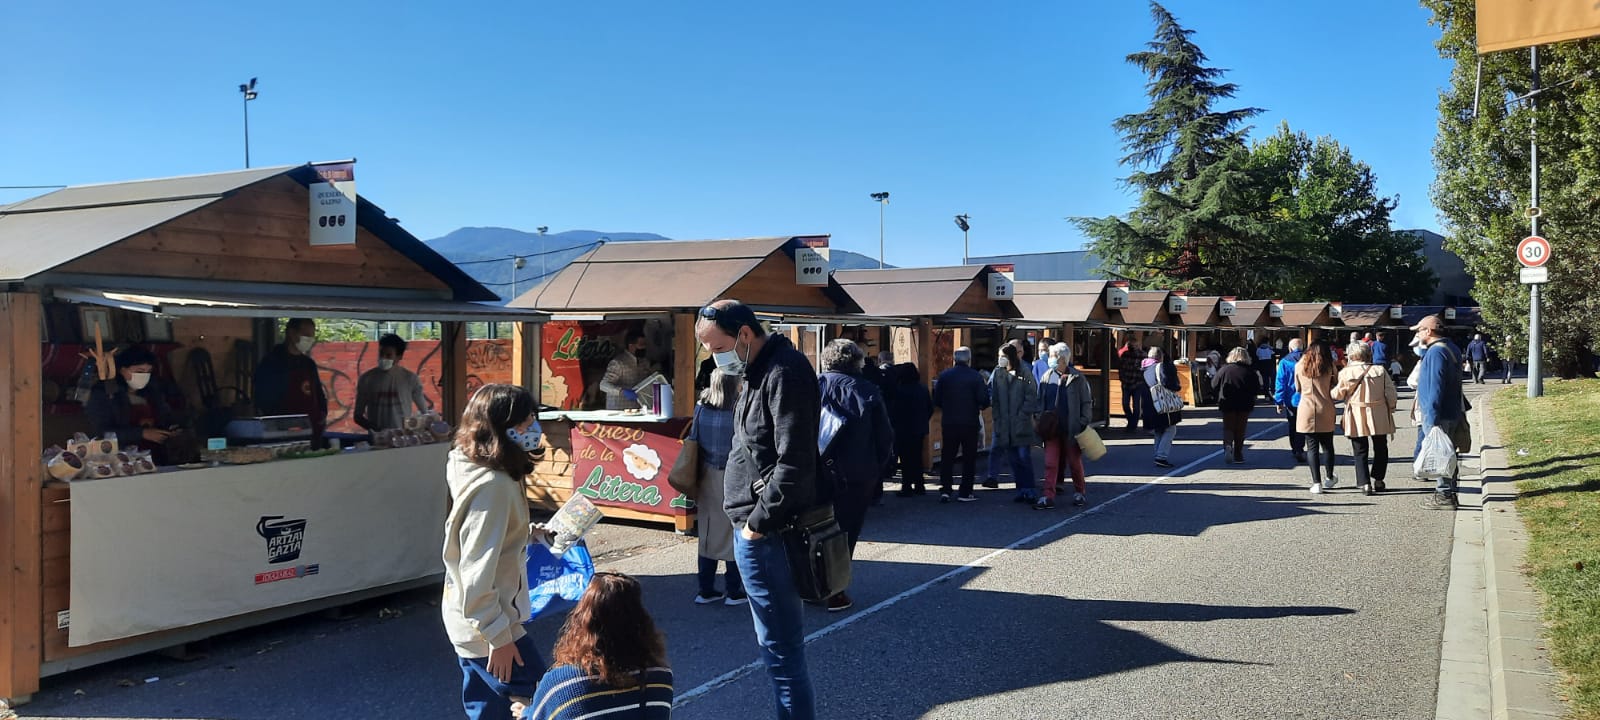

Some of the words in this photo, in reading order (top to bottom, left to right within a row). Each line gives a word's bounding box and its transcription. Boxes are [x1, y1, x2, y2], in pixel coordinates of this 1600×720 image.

[1525, 246, 1542, 258] 30
[578, 421, 645, 442] Queso
[579, 444, 597, 461] de
[601, 446, 616, 462] la
[576, 464, 663, 506] Litera
[269, 532, 302, 548] ARTZAI
[268, 541, 301, 559] GAZTA
